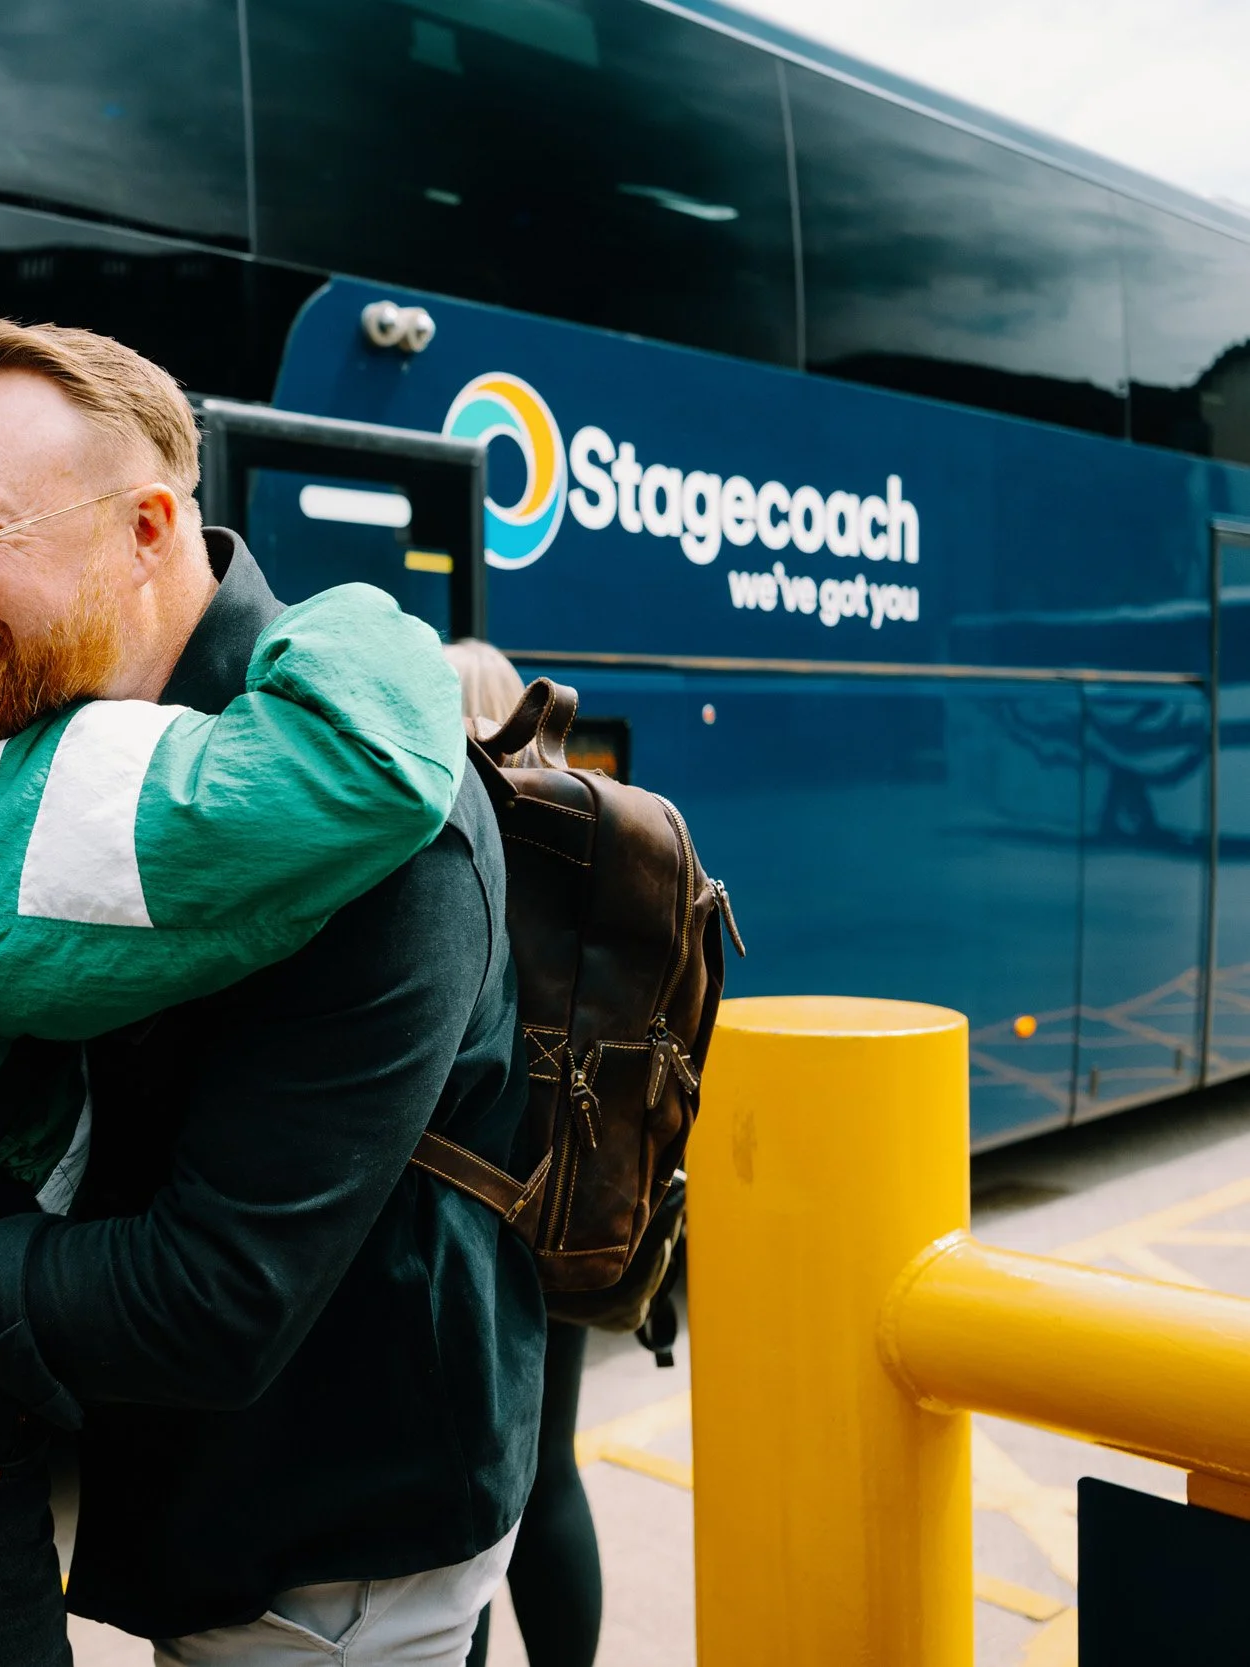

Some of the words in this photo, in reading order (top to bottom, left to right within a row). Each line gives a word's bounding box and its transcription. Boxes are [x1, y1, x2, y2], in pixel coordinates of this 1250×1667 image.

[568, 425, 920, 565] Stagecoach
[728, 560, 818, 614] we've
[819, 573, 869, 627] got
[869, 582, 920, 630] you
